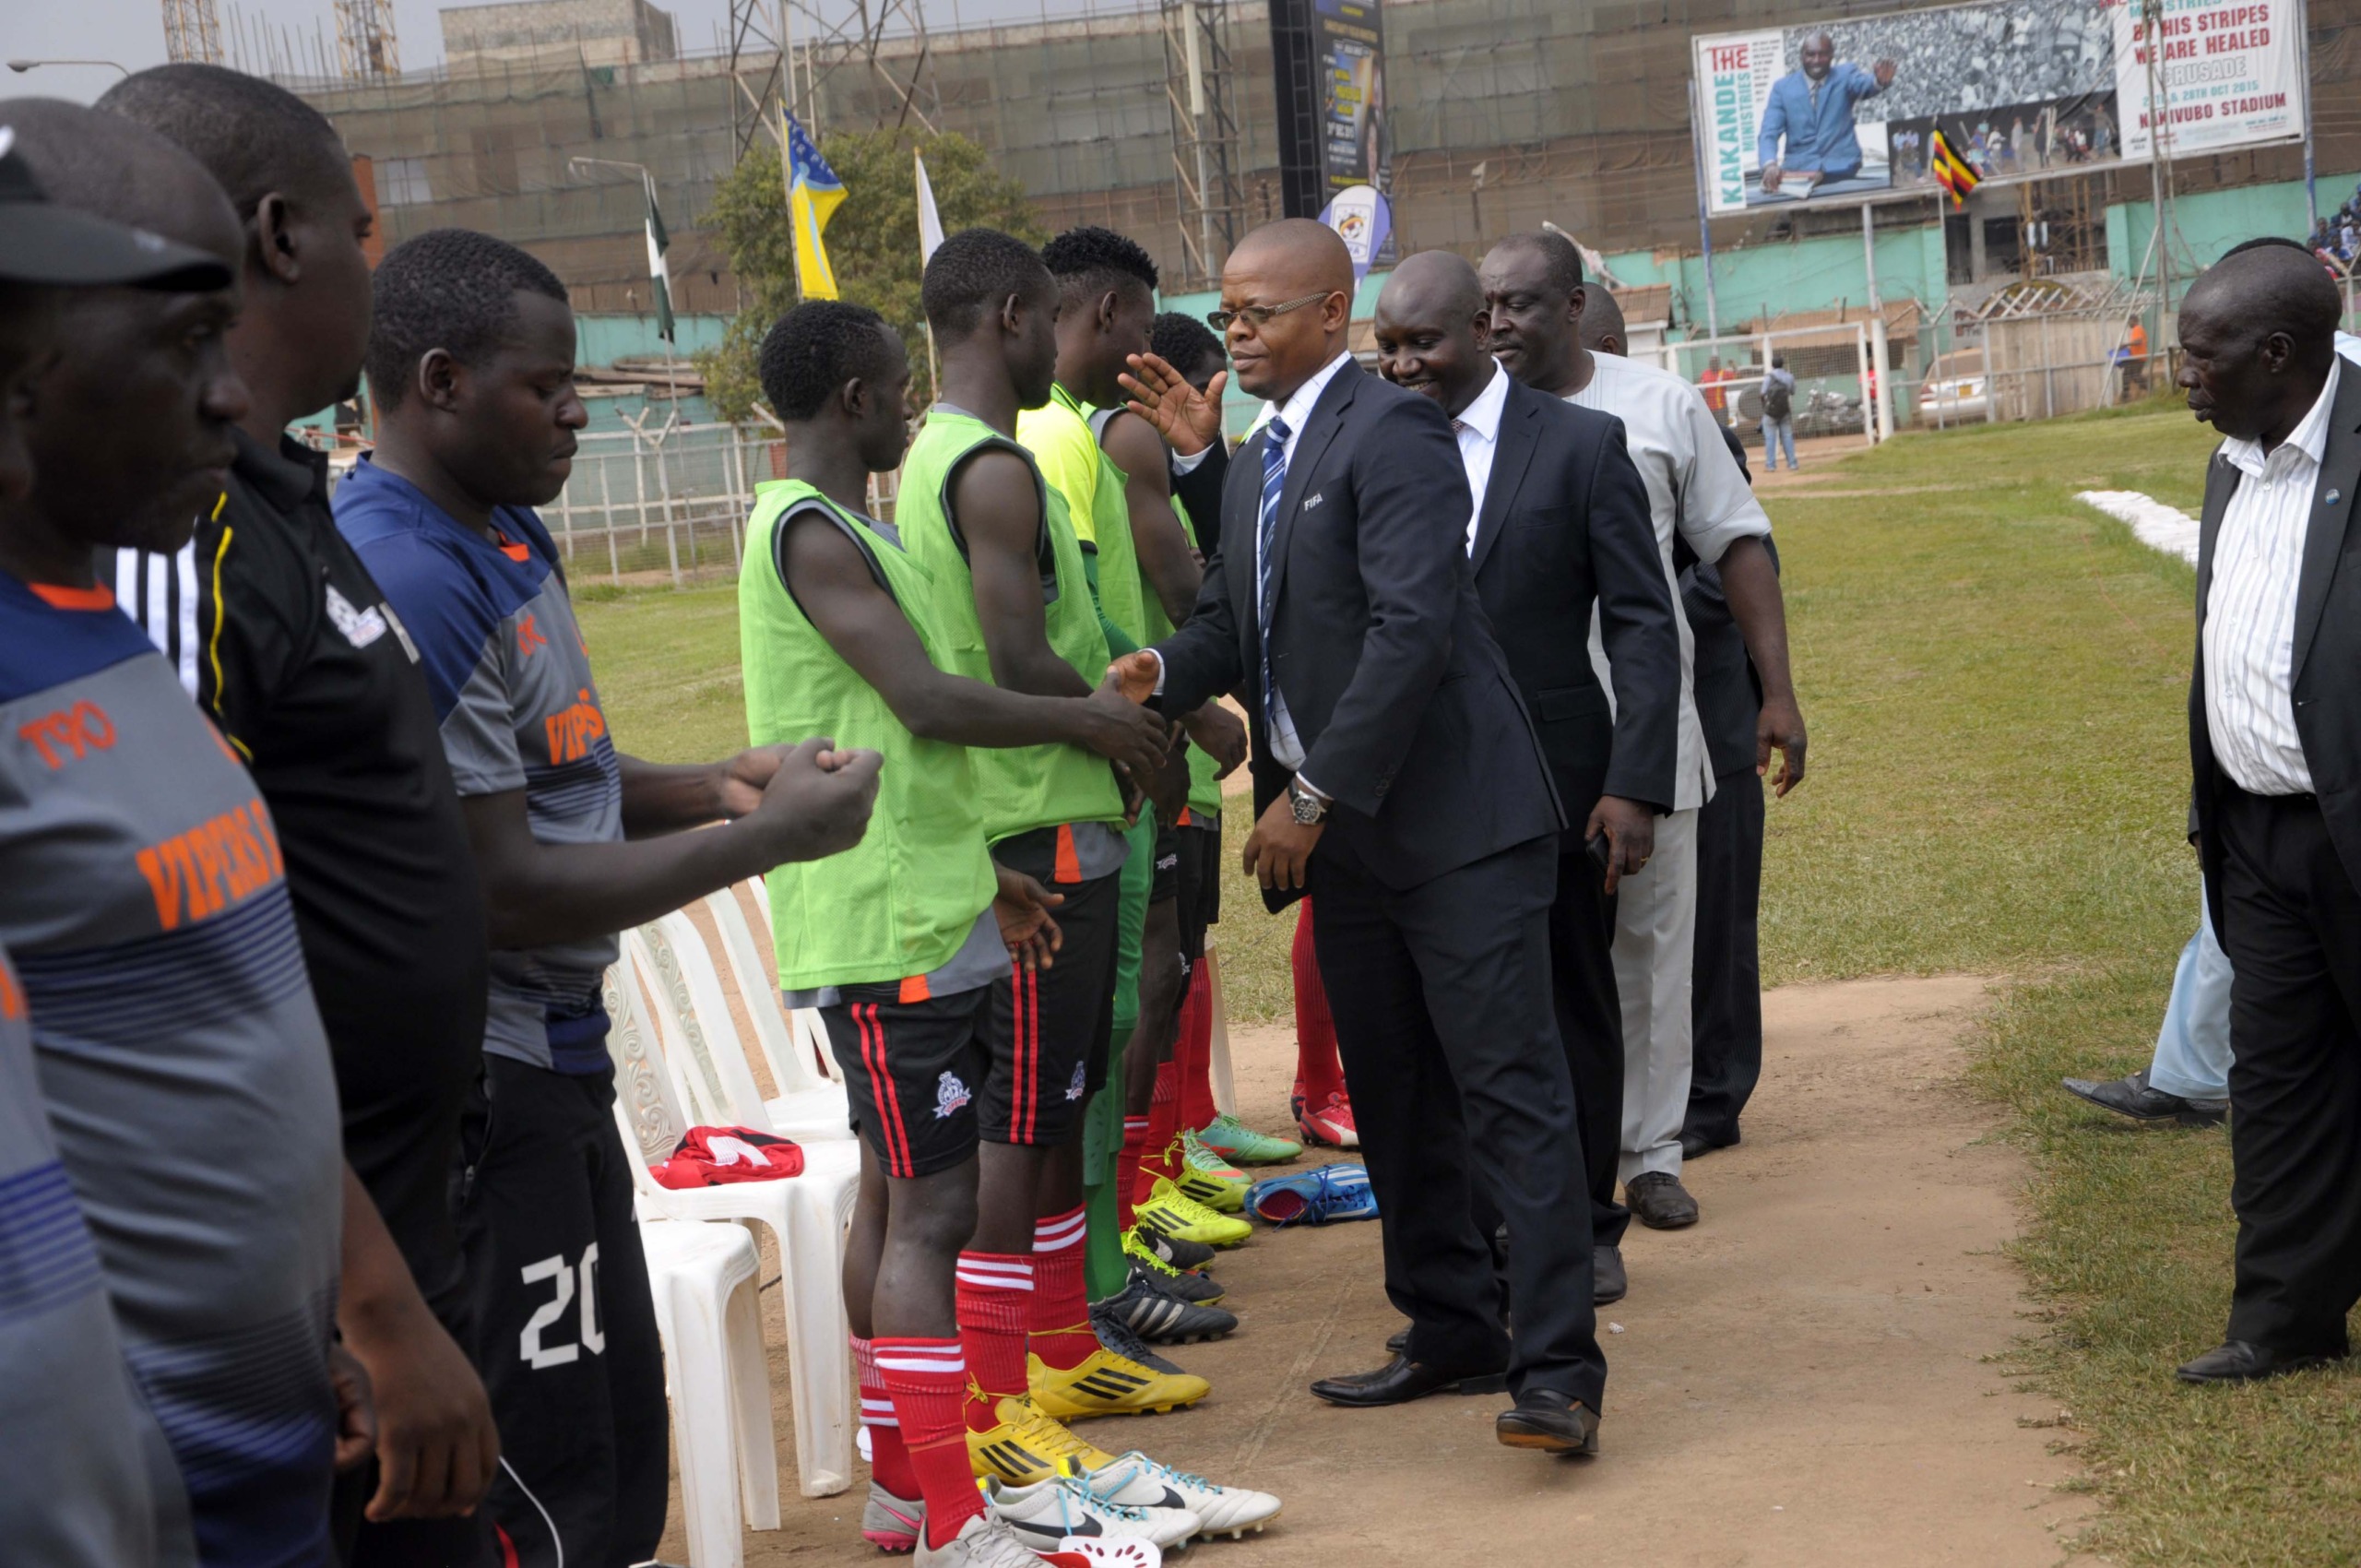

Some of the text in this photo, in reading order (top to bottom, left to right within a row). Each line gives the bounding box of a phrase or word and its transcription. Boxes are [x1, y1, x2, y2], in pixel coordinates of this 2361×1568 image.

[2161, 16, 2191, 37] HIS
[2198, 5, 2269, 32] STRIPES
[1709, 44, 1750, 72] THE
[2134, 28, 2270, 65] WE ARE HEALED
[2165, 55, 2247, 88] CRUSADE
[2211, 84, 2229, 96] OCT
[2233, 80, 2260, 93] 2015
[2221, 92, 2286, 116] STADIUM
[1737, 72, 1755, 152] MINISTRIES
[1714, 74, 1743, 204] KAKANDE
[1304, 493, 1323, 512] FIFA
